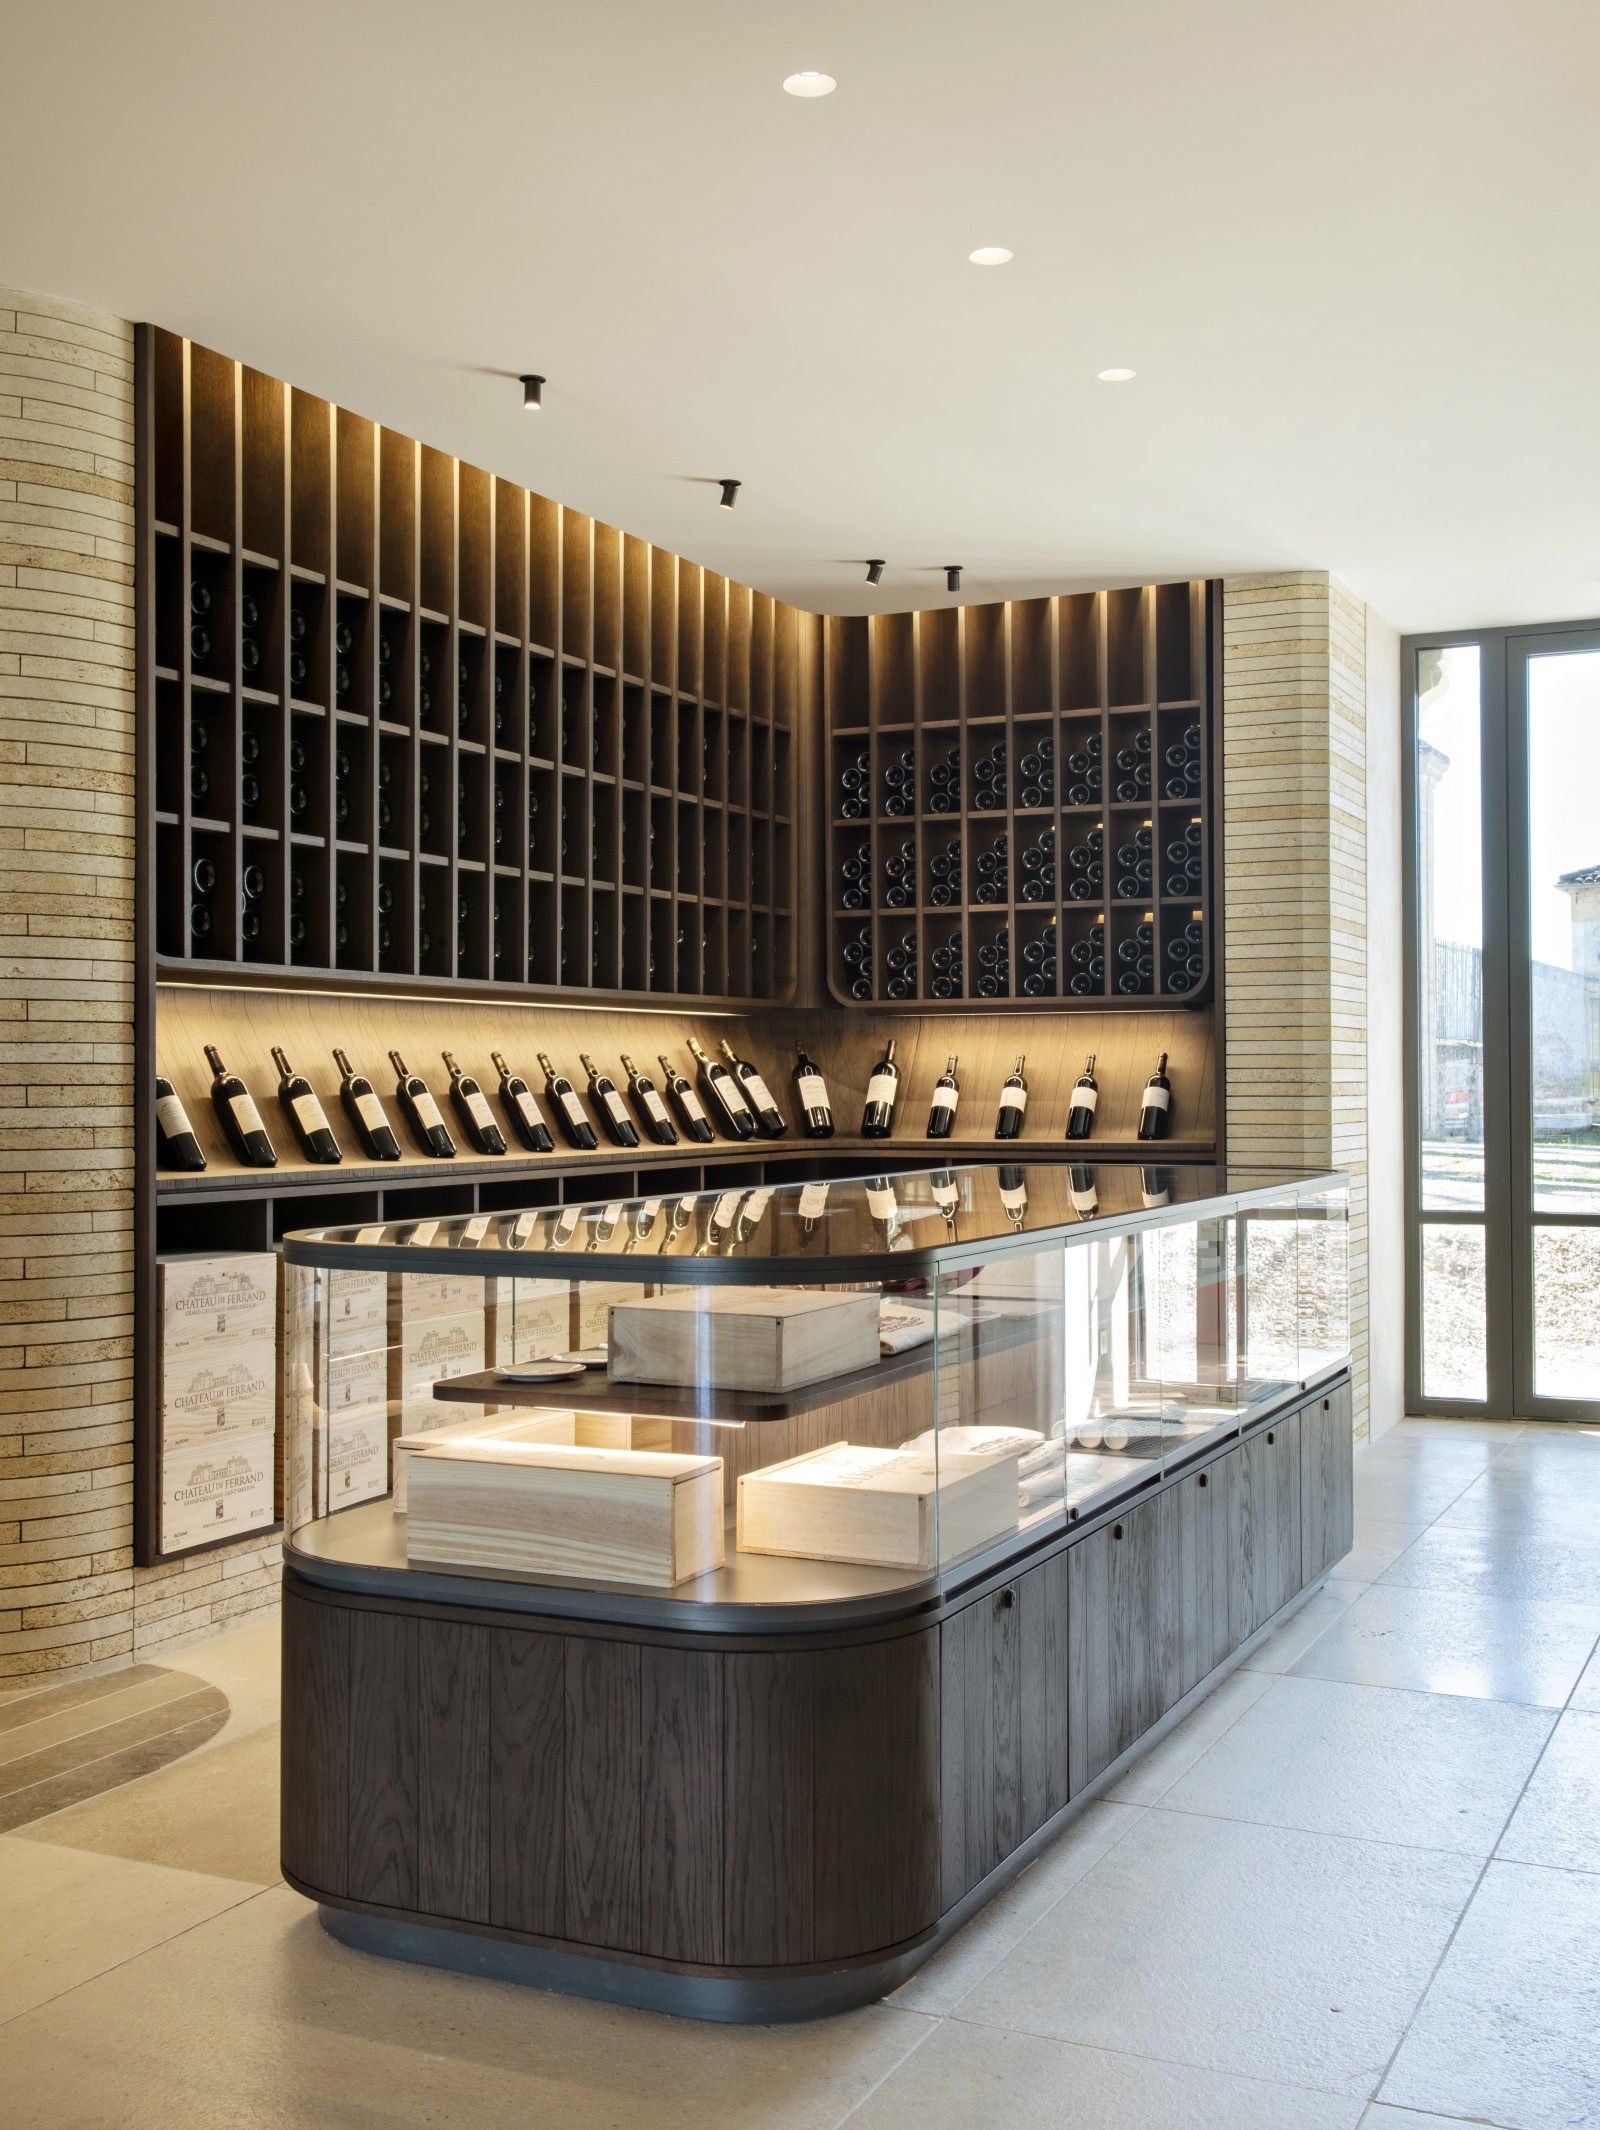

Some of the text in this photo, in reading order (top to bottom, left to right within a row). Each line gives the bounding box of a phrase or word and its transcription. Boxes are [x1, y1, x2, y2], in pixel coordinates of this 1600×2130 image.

[351, 1276, 379, 1290] FERRAND
[175, 1290, 266, 1311] CHATEAU DE FERRAND
[536, 1324, 562, 1337] FERRAND
[409, 1348, 440, 1363] CHATEAU
[448, 1341, 477, 1355] FERRAND
[174, 1380, 265, 1408] CHATEAU DE FERRAND
[351, 1445, 379, 1461] FERRAND
[174, 1472, 264, 1501] CHATEAU DE FERRAND
